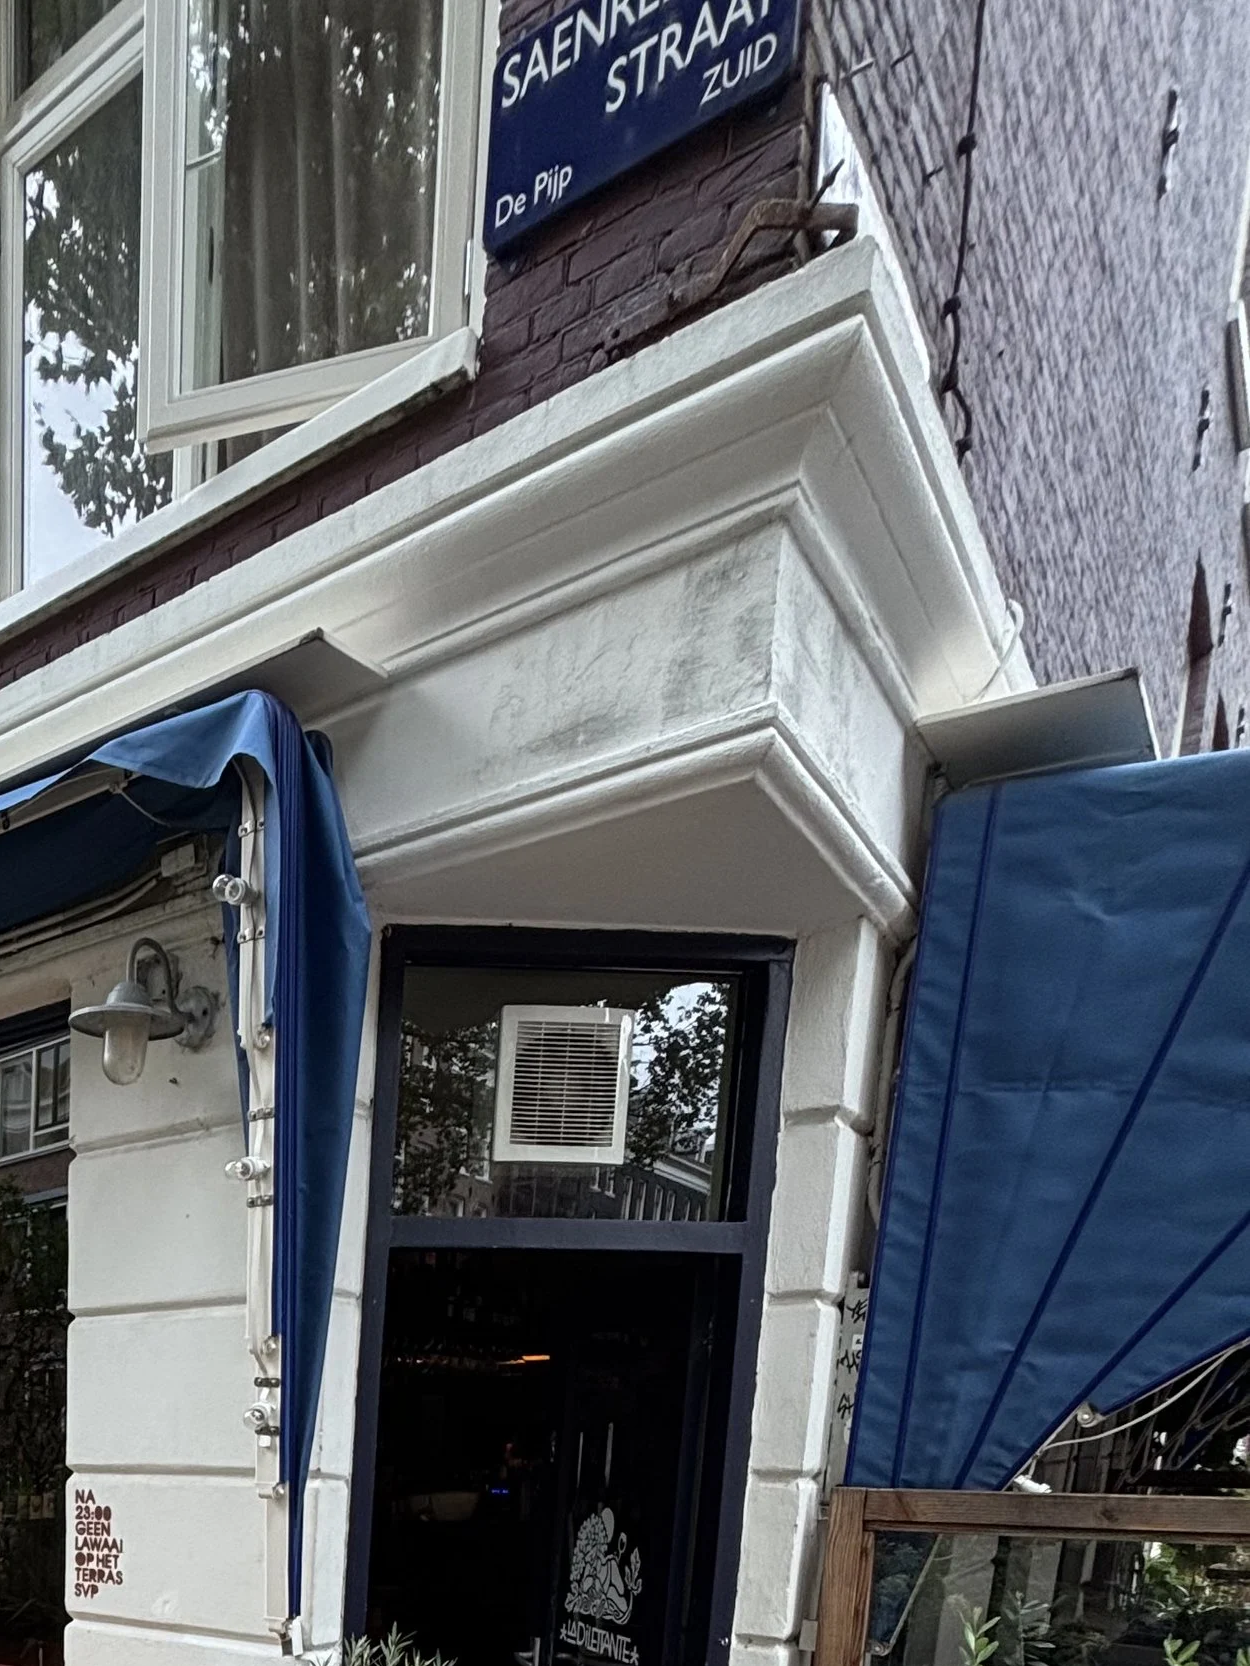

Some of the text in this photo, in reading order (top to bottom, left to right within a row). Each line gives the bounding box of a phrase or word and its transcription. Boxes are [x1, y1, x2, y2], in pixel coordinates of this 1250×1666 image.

[700, 32, 778, 106] ZUID
[495, 164, 573, 229] De Pijp
[75, 1489, 96, 1505] NA
[75, 1505, 112, 1521] 23:00
[75, 1521, 111, 1536] GEEN
[75, 1536, 123, 1553] LAWAAI
[75, 1552, 119, 1569] OP HET
[75, 1567, 123, 1585] TERRAS
[74, 1583, 99, 1599] SVP
